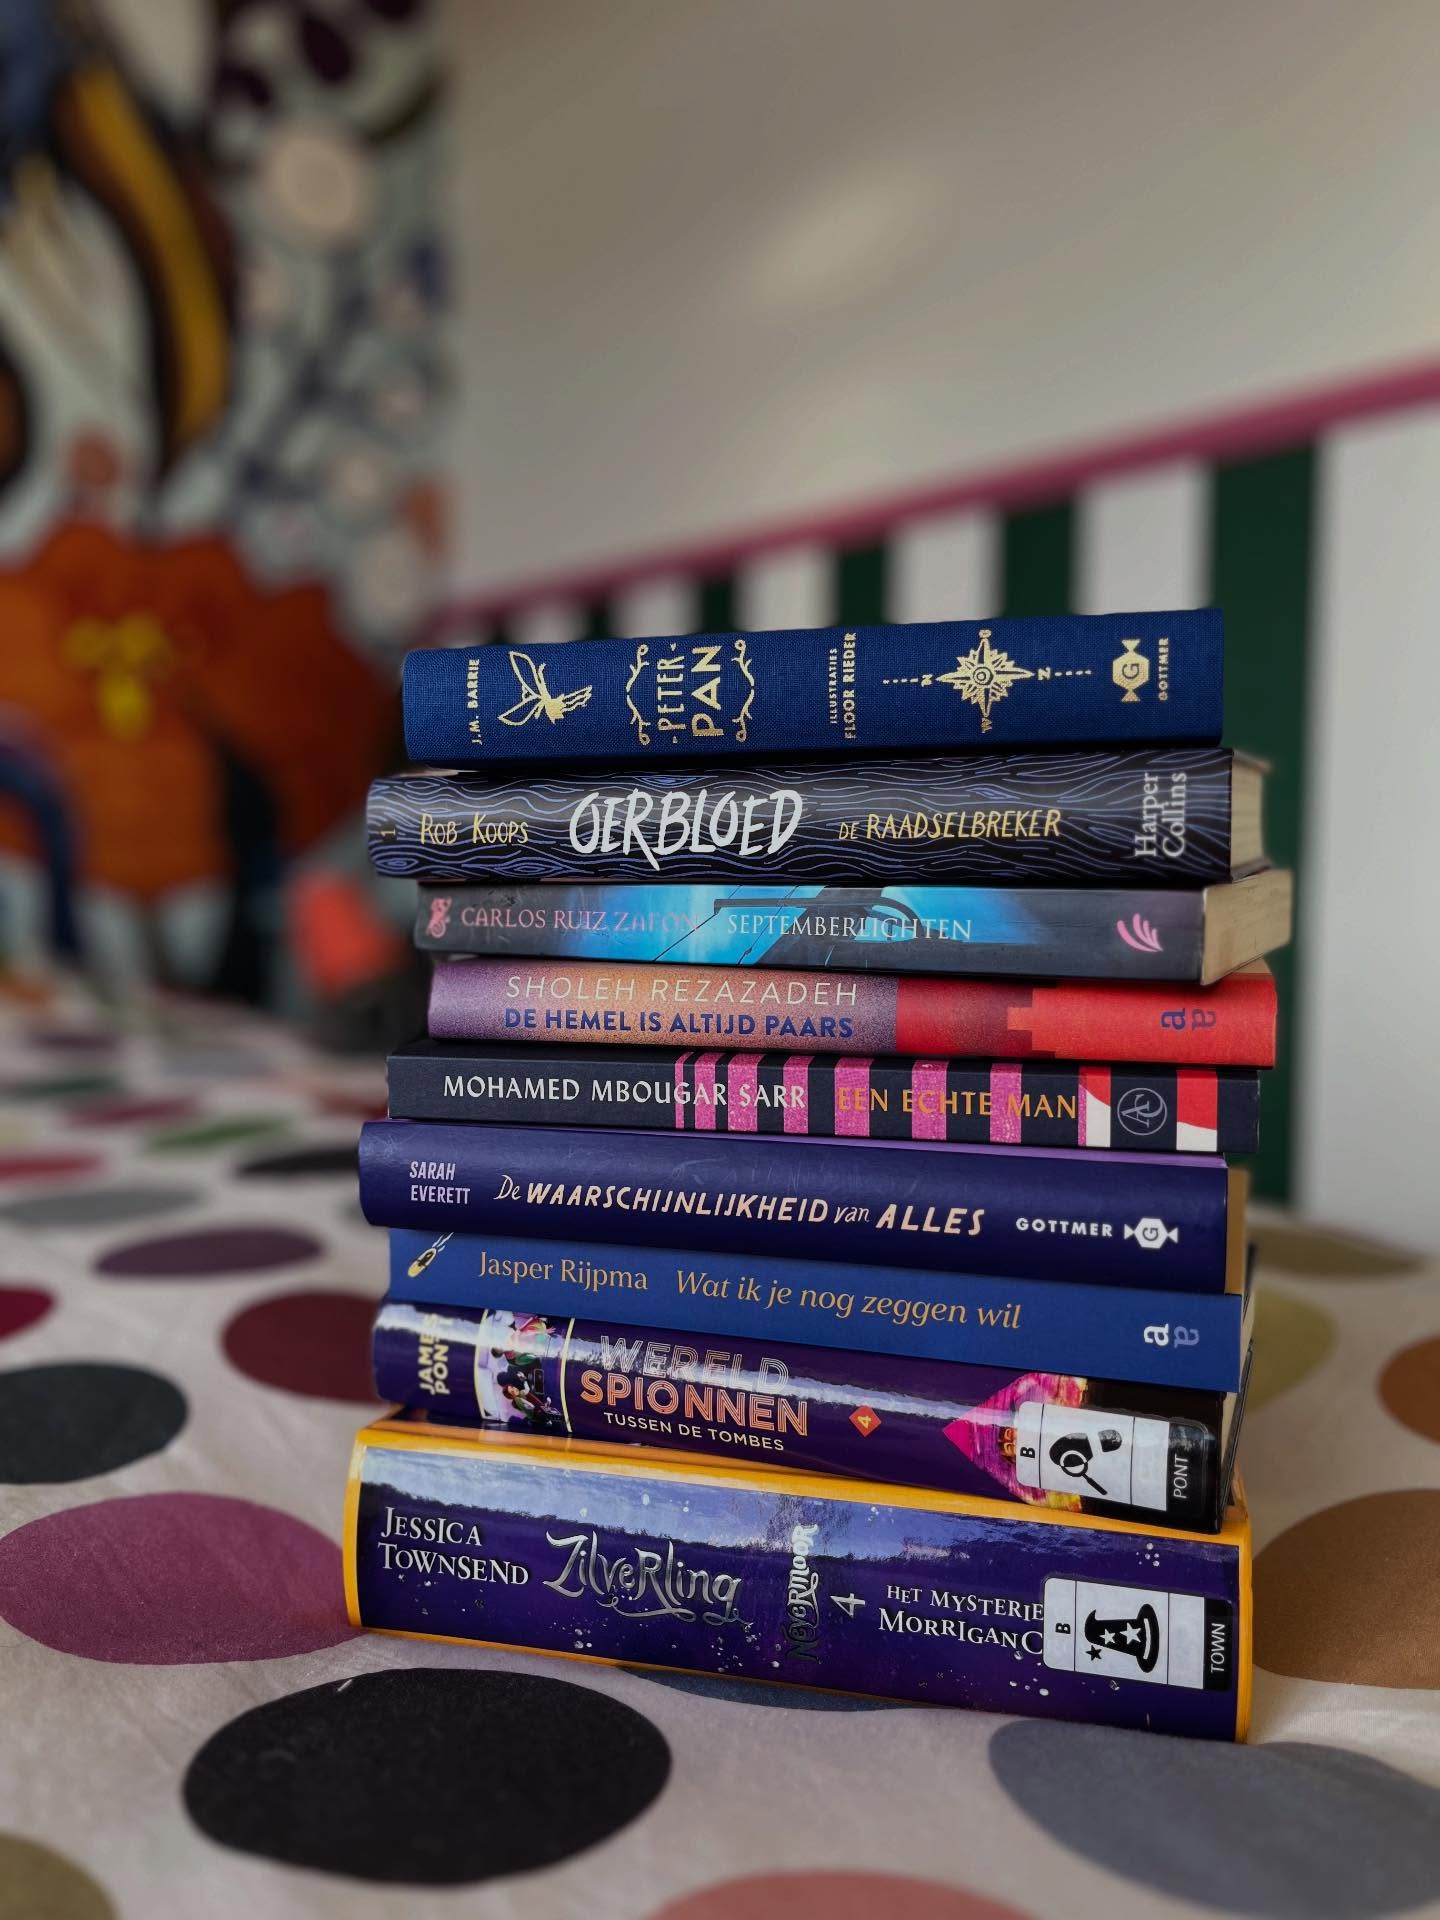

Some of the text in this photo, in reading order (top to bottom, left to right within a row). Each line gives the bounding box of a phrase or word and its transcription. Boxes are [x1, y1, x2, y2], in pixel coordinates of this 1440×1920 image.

[829, 648, 838, 724] ILLUSTRATIES
[842, 632, 857, 739] FLOOR RIEDER
[1158, 637, 1170, 700] GOTTMER
[466, 658, 484, 746] J.M. BARRIE
[656, 653, 686, 732] PETER
[690, 645, 725, 738] PAN
[419, 811, 529, 845] ROB KOOPS
[568, 788, 802, 871] OERBLOED
[838, 809, 1061, 840] DE RAADSELBREKER
[1134, 772, 1159, 858] Harper
[1162, 771, 1188, 859] Collins
[460, 907, 546, 929] CARLOS
[553, 909, 608, 931] RUIZ
[727, 913, 972, 942] SEPTEMBERLICHTEN
[505, 975, 859, 1007] SHOLEH REZAZADEH
[504, 1008, 853, 1039] DE HEMEL IS ALTIJD PAARS
[443, 1075, 806, 1110] MOHAMED MBOUGAR SARR
[837, 1086, 1078, 1120] EEN ECHTE MAN
[409, 1160, 456, 1181] SARAH
[410, 1184, 470, 1206] EVERETT
[493, 1174, 985, 1236] De WAARSCHIJNLIJKHEID van ALLES
[1015, 1217, 1113, 1238] GOTTMER
[479, 1250, 648, 1292] Jasper Rijpma
[676, 1270, 1022, 1329] Wat ik je nog zeggen wil
[600, 1335, 790, 1397] WERELD
[580, 1369, 808, 1437] SPIONNEN
[857, 1414, 872, 1429] 4
[603, 1412, 785, 1452] TUSSEN DE TOMBES
[1019, 1446, 1036, 1459] B
[1173, 1454, 1190, 1499] PONT
[380, 1506, 482, 1547] JESSICA
[378, 1542, 529, 1586] TOWNSEND
[830, 1592, 866, 1618] 4
[886, 1584, 1044, 1621] HET MYSTERIE
[1055, 1622, 1071, 1635] B
[1210, 1623, 1227, 1673] TOWN
